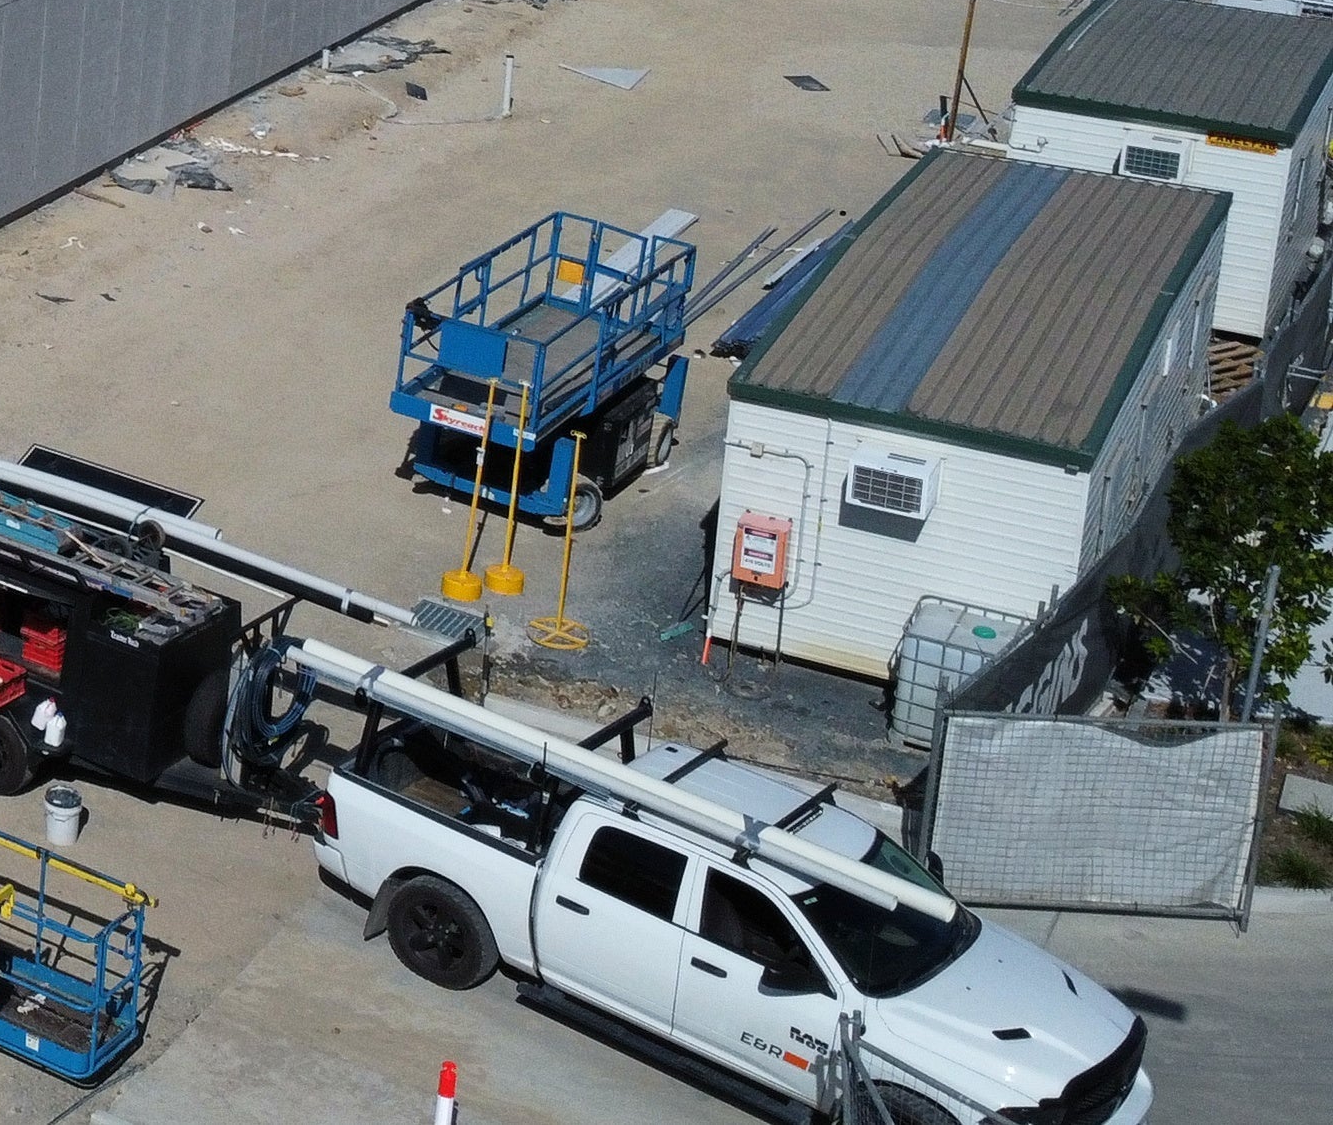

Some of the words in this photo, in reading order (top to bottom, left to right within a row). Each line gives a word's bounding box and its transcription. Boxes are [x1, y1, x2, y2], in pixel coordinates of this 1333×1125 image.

[740, 1031, 783, 1059] E&R
[790, 1026, 829, 1050] RAM
[790, 1031, 828, 1056] 1500
